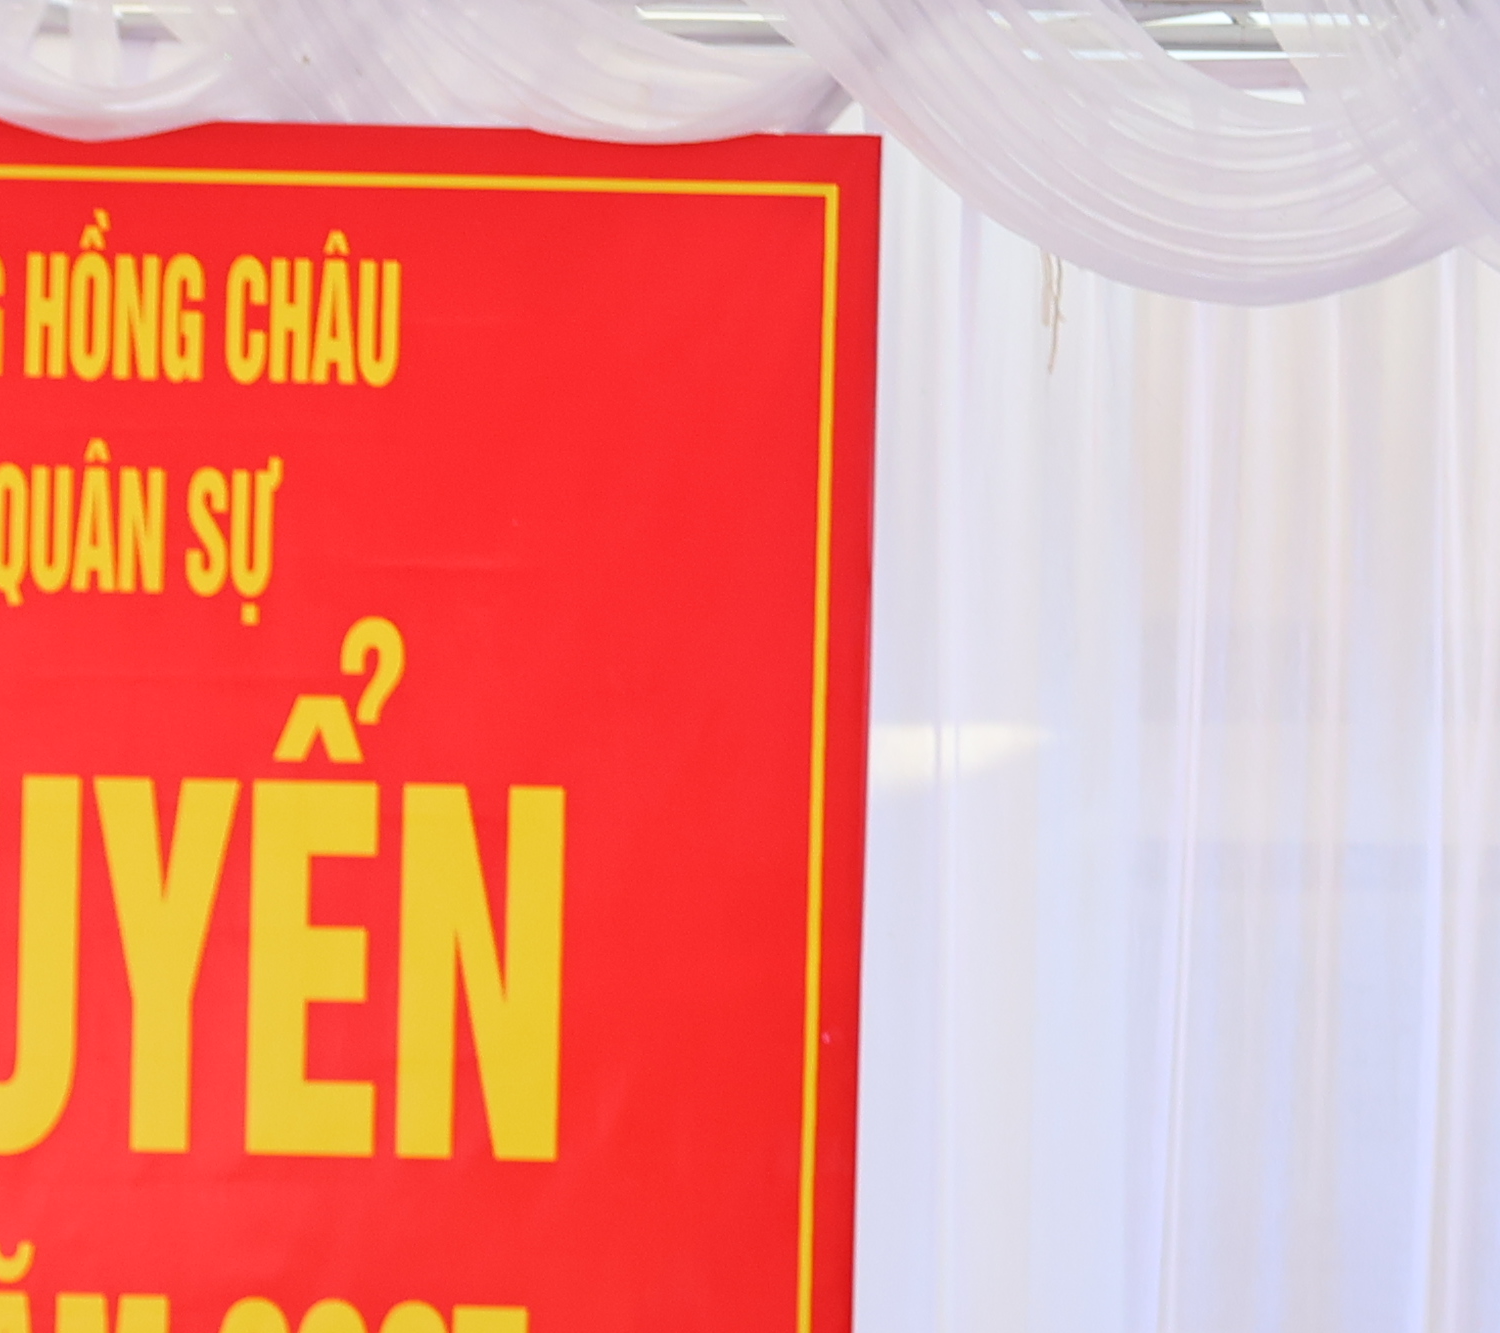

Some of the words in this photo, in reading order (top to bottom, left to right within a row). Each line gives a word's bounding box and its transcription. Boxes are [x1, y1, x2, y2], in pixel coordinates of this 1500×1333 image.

[24, 210, 204, 382] HỒNG
[226, 231, 400, 387] CHÂU
[186, 457, 282, 625] SỰ
